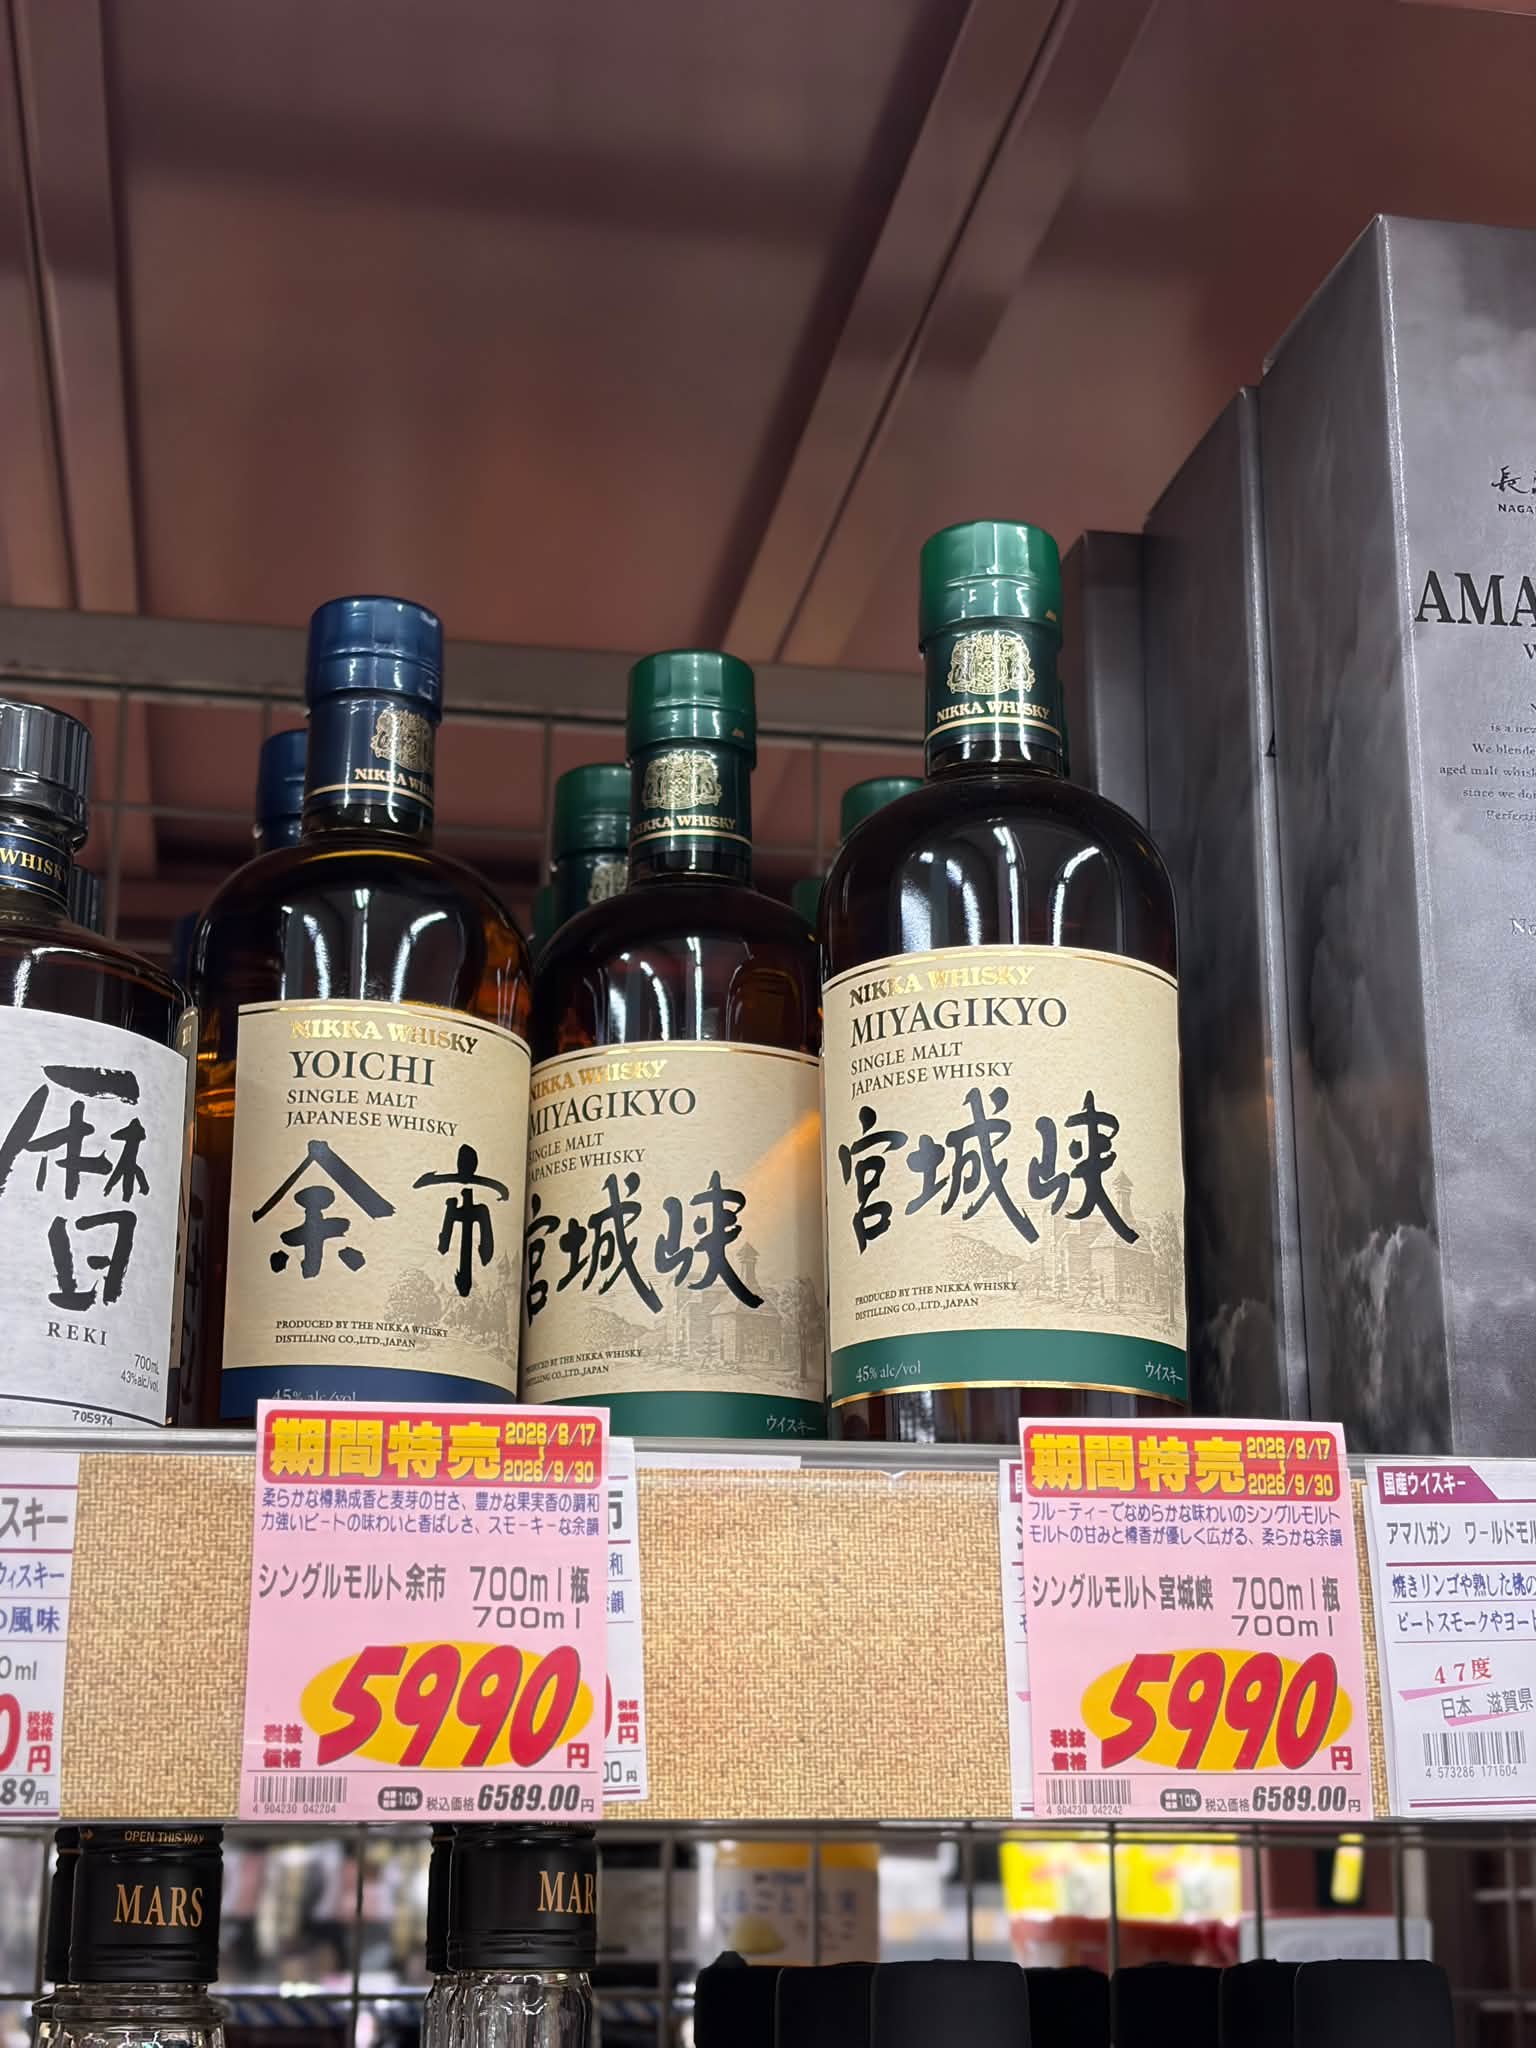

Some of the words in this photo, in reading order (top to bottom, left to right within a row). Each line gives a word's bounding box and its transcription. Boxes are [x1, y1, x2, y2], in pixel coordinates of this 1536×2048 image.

[937, 702, 984, 722] NIKKA
[987, 701, 1050, 719] WHISKY
[1472, 743, 1492, 754] We
[355, 768, 407, 786] NIKKA
[1439, 765, 1466, 777] aged
[677, 815, 736, 830] WHISKY
[849, 973, 923, 1008] NIKKA
[927, 964, 1034, 990] WHISKY
[850, 996, 1068, 1047] MIYAGIKYO
[290, 1019, 382, 1040] NIKKA
[387, 1023, 479, 1054] WHISKY
[289, 1050, 435, 1086] YOICHI
[851, 1049, 905, 1075] SINGLE
[911, 1041, 963, 1060] MALT
[578, 1060, 668, 1085] WHISKY
[851, 1068, 928, 1099] JAPANESE
[933, 1062, 1013, 1081] WHISKY
[287, 1089, 358, 1104] SINGLE
[366, 1092, 418, 1109] MALT
[286, 1112, 381, 1128] JAPANESE
[388, 1114, 458, 1137] WHISKY
[565, 1132, 604, 1150] MALT
[580, 1149, 645, 1167] WHISKY
[838, 1086, 1139, 1255] 宮城峡
[252, 1140, 509, 1297] 余市
[855, 1291, 897, 1305] PRODUCED
[899, 1288, 910, 1298] BY
[912, 1287, 933, 1296] THE
[936, 1284, 971, 1294] NIKKA
[973, 1282, 1018, 1291] WHISKY
[855, 1305, 900, 1321] DISTILLING
[47, 1321, 108, 1346] REKI
[275, 1335, 336, 1344] DISTILLING
[276, 1320, 333, 1329] PRODUCED
[336, 1321, 348, 1329] BY
[351, 1321, 373, 1330] THE
[376, 1322, 410, 1333] NIKKA
[411, 1325, 448, 1338] WHISKY
[576, 1351, 603, 1362] NIKKA
[605, 1349, 641, 1359] WHISKY
[855, 1365, 877, 1382] 45%
[879, 1360, 921, 1379] alc/vol
[1145, 1361, 1183, 1385] ウイスキー
[72, 1408, 113, 1427] 705974
[766, 1415, 817, 1433] ウイスキー
[271, 1417, 501, 1480] 期間特売
[505, 1421, 596, 1448] 2026/8/17
[503, 1459, 594, 1484] 2026/9/30
[1030, 1433, 1246, 1494] 期間特売
[1246, 1436, 1331, 1462] 2026/8/17
[1248, 1473, 1335, 1497] 2026/9/30
[1383, 1472, 1466, 1496] 国産ウイスキー
[1387, 1521, 1451, 1545] アマハガン
[258, 1562, 447, 1602] シングルモルト余市
[1032, 1573, 1214, 1611] シングルモルト宮城峡
[1441, 1696, 1473, 1720] 日本
[1487, 1688, 1534, 1714] 滋賀県
[1438, 1767, 1475, 1778] 573286
[264, 1804, 297, 1814] 904230
[426, 1797, 474, 1812] 税込価格
[1057, 1806, 1087, 1815] 904230
[1205, 1798, 1250, 1812] 税込価格
[124, 1831, 155, 1842] OPEN
[159, 1832, 181, 1842] THIS
[113, 1884, 203, 1927] MARS
